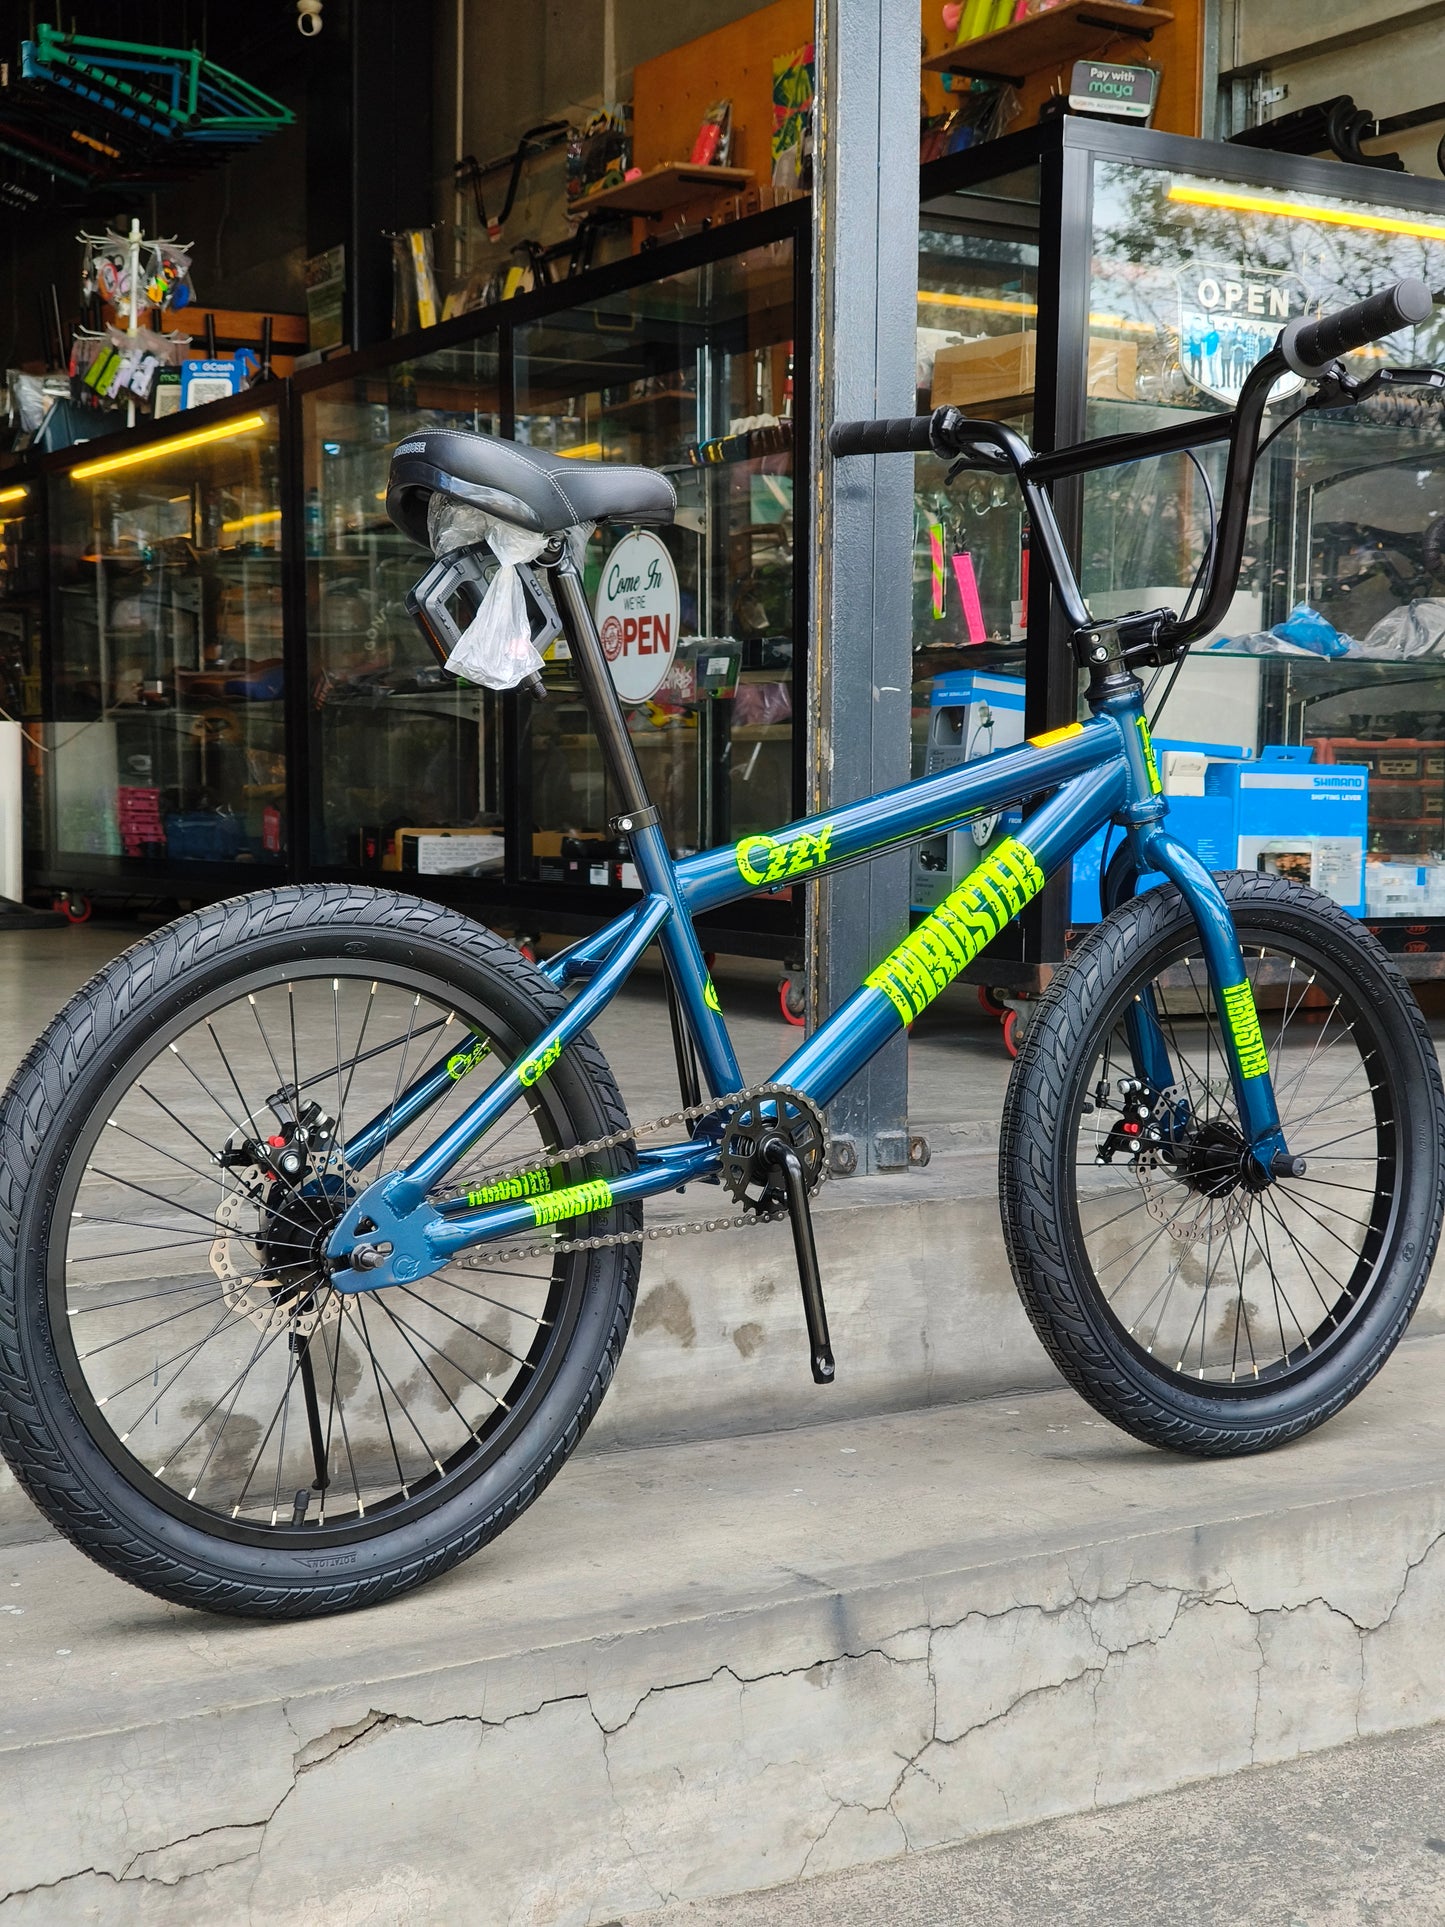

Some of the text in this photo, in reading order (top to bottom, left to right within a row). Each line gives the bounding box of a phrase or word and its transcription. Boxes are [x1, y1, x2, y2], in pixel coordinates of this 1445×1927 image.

[1090, 67, 1135, 82] Pay with
[1088, 81, 1134, 98] maya
[1198, 279, 1290, 317] OPEN
[608, 559, 662, 601] Come In
[624, 595, 646, 611] WE'RE
[601, 613, 671, 662] OPEN
[1313, 777, 1362, 788] SHIMANO
[312, 1555, 356, 1568] ROTATION
